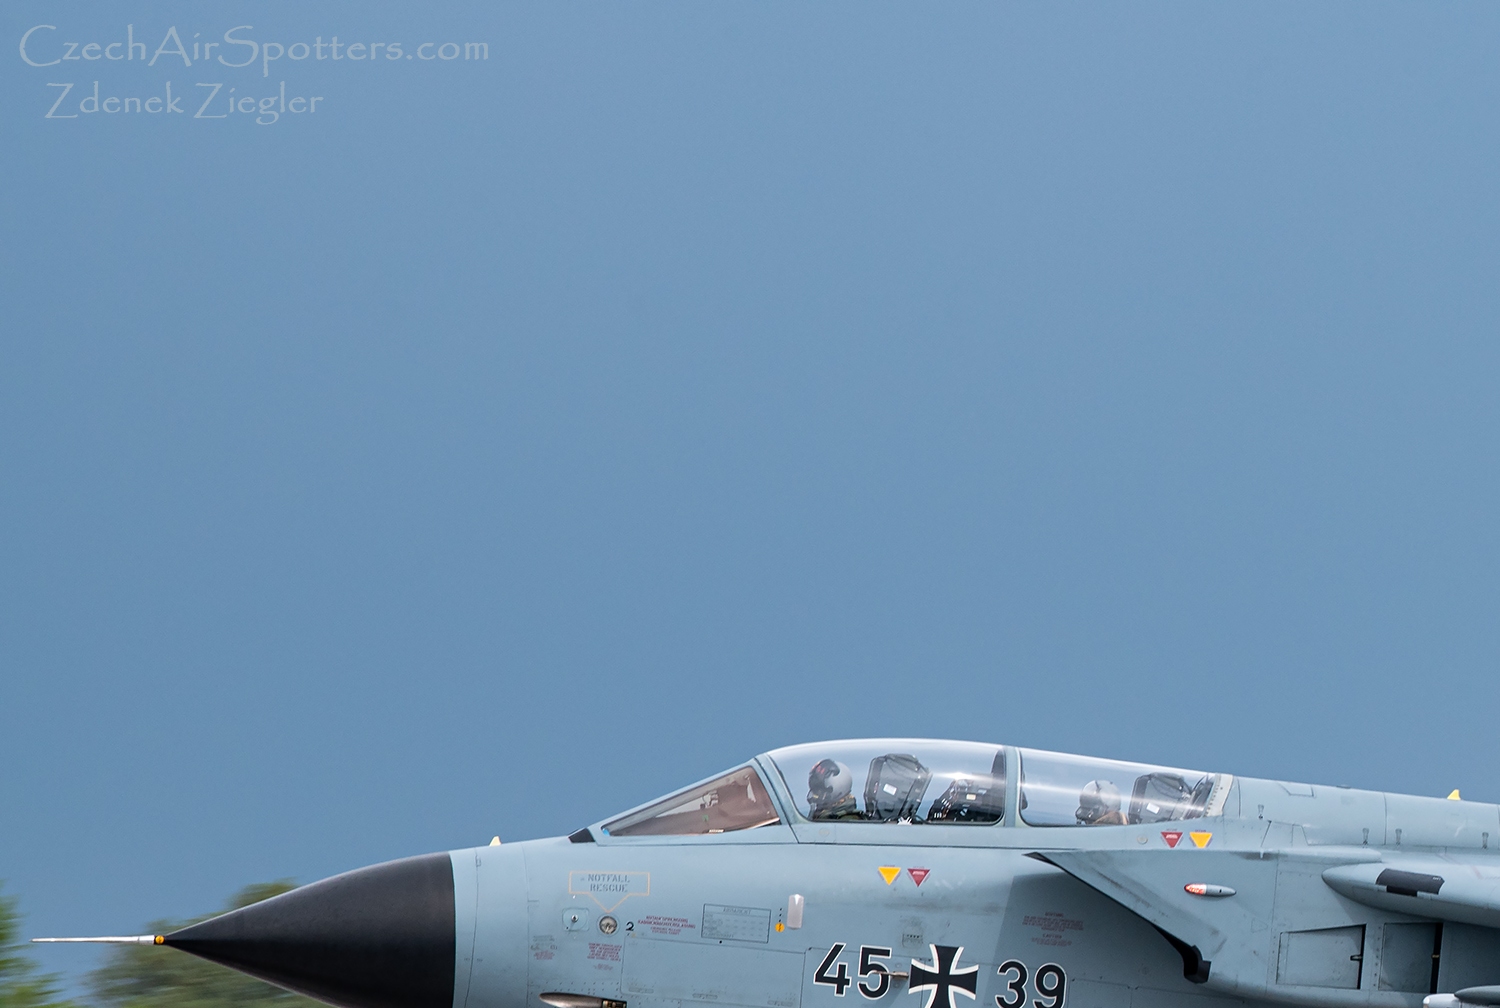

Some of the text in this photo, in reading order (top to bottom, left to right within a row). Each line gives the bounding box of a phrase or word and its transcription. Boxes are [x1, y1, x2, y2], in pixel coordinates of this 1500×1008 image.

[588, 873, 630, 883] NOTFALL
[590, 883, 628, 893] RESCUE
[625, 921, 635, 932] 2
[813, 942, 893, 1000] 45
